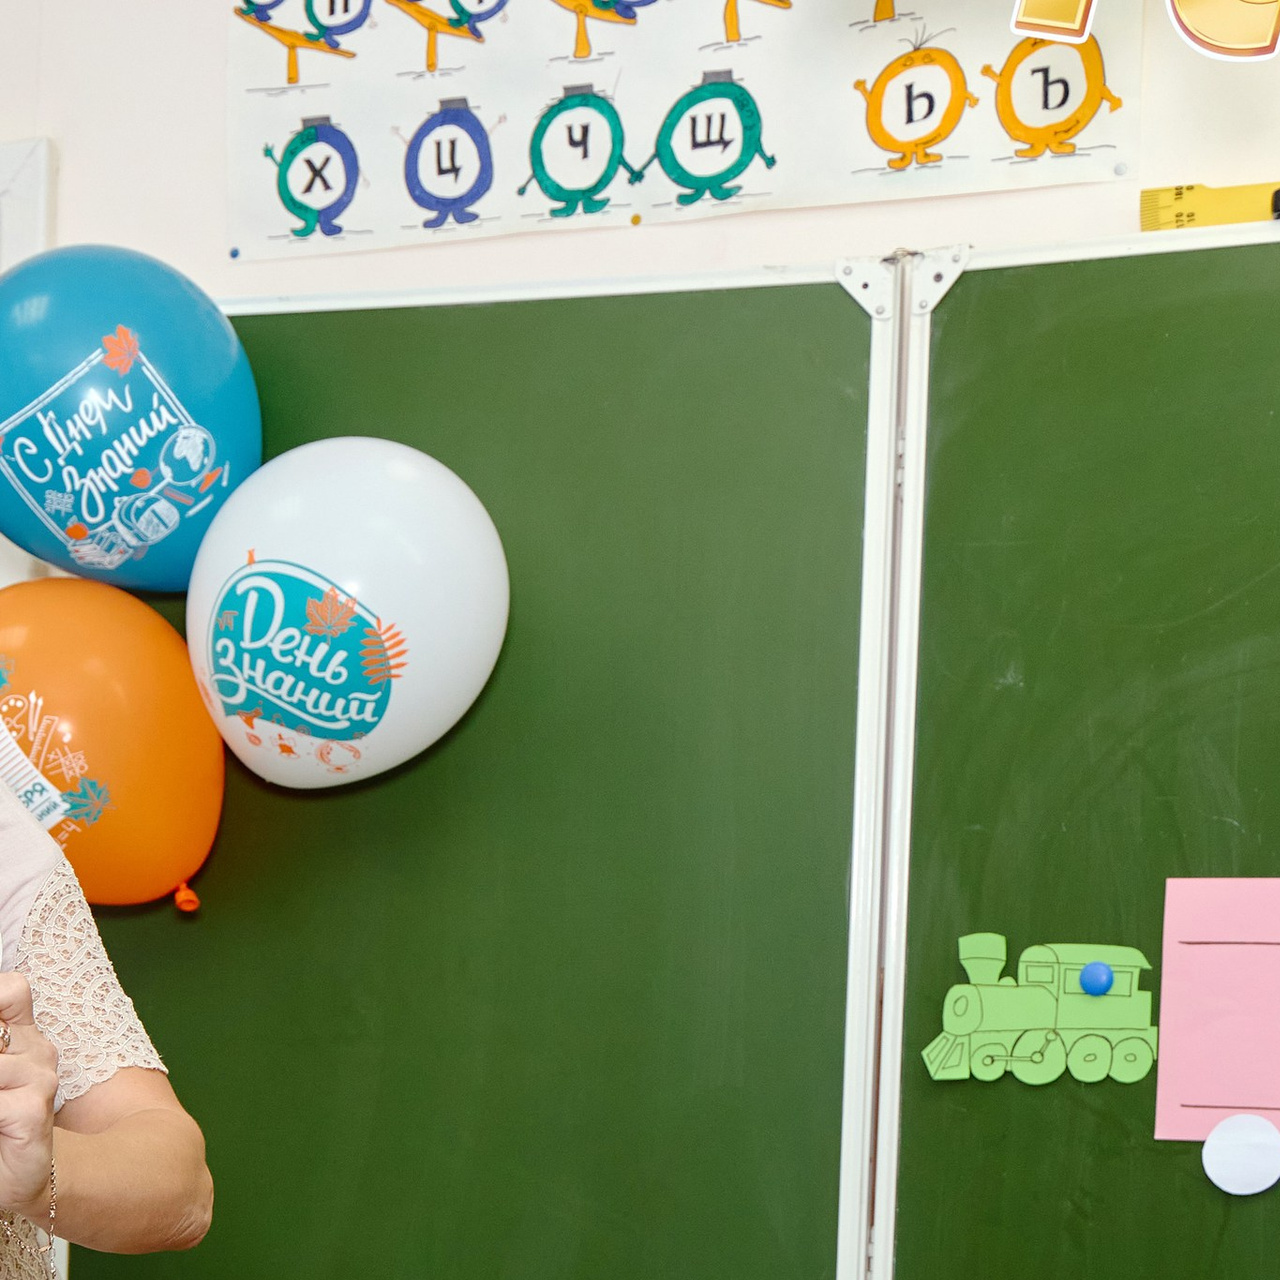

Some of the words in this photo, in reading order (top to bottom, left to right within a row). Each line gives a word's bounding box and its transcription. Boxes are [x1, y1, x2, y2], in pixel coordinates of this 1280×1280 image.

[36, 383, 133, 466] Днем
[235, 575, 349, 685] День
[210, 637, 383, 730] Знаний
